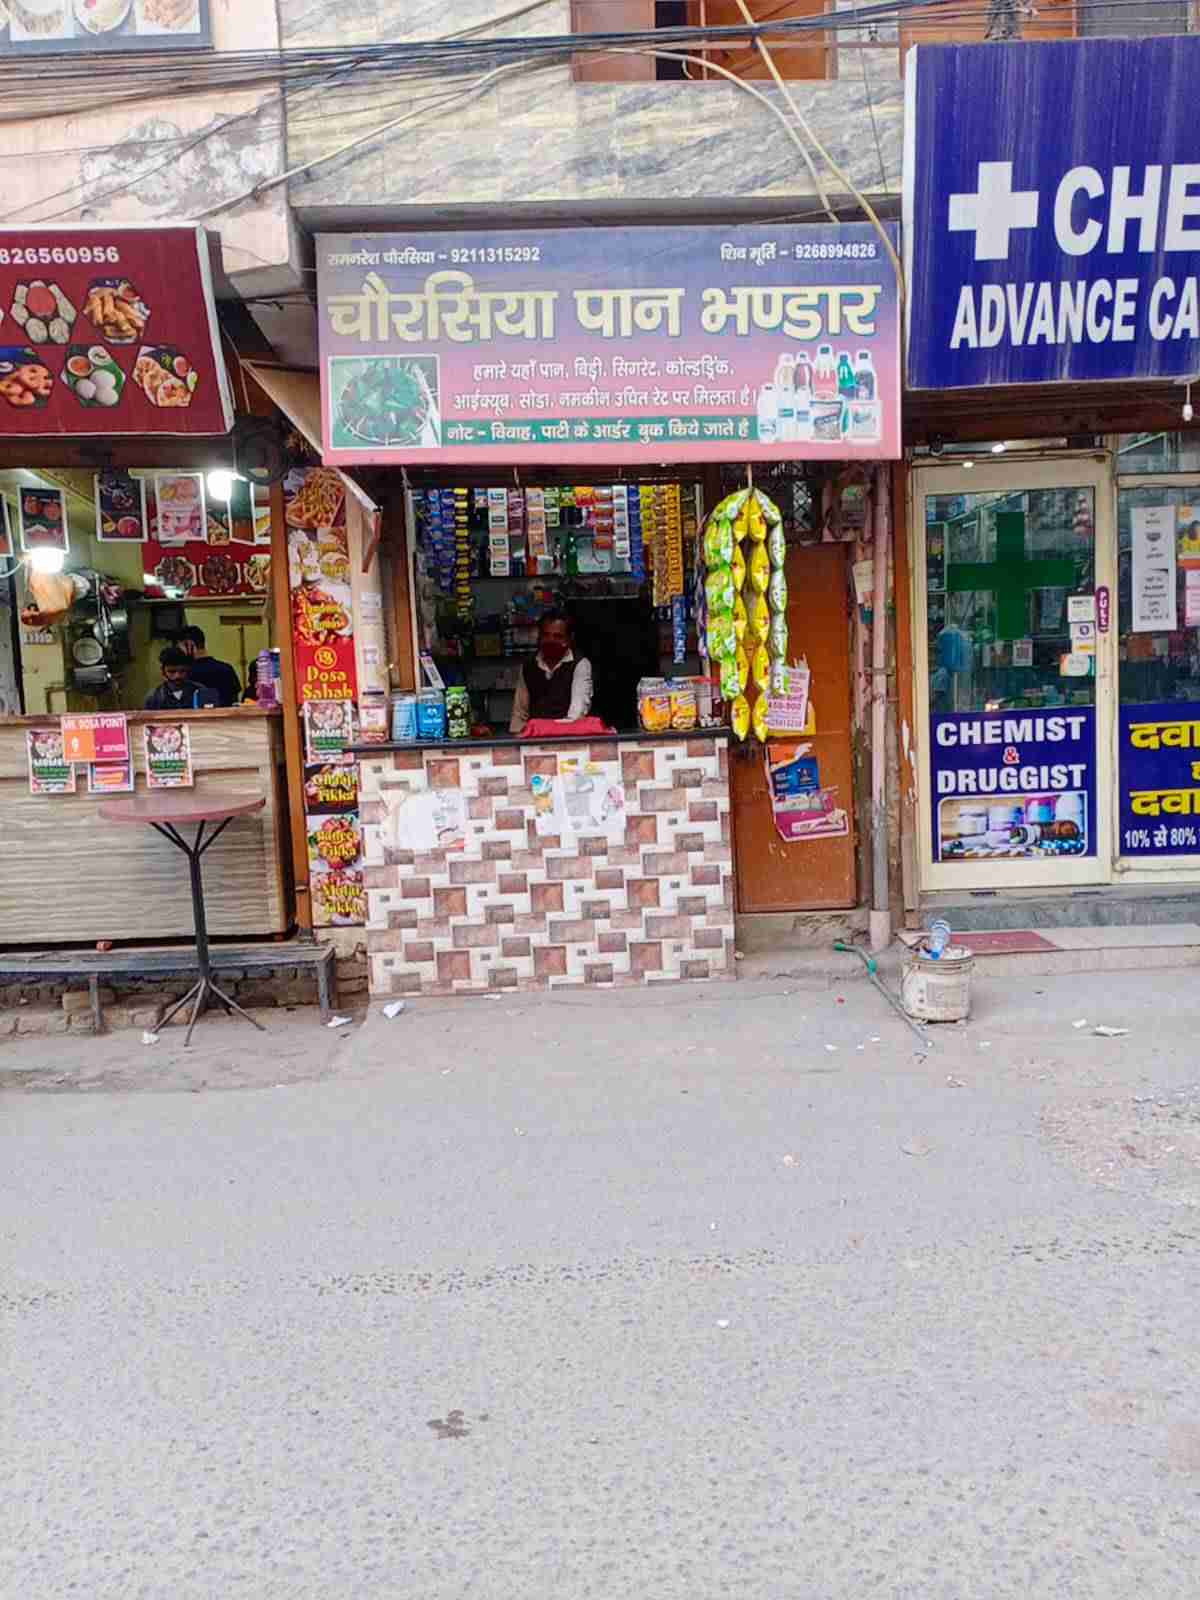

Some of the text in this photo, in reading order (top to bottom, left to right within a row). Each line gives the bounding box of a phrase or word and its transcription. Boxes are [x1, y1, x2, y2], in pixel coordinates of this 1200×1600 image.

[1053, 164, 1200, 256] CHE
[451, 247, 540, 262] 9211315292
[327, 270, 882, 342] चौरसिया पान भण्डार
[950, 278, 1139, 350] ADVANCE
[473, 359, 506, 382] हमारे
[654, 386, 669, 406] रेट
[672, 391, 690, 406] पर
[694, 384, 736, 407] मिलता
[447, 423, 473, 441] नोट
[574, 421, 588, 438] के
[638, 423, 664, 445] बुक
[703, 418, 735, 437] जाते
[307, 665, 347, 682] Dosa
[936, 716, 1087, 746] CHEMIST
[1003, 746, 1020, 765] &
[937, 764, 1087, 794] DRUGGIST
[1125, 824, 1197, 848] 10% से 80%
